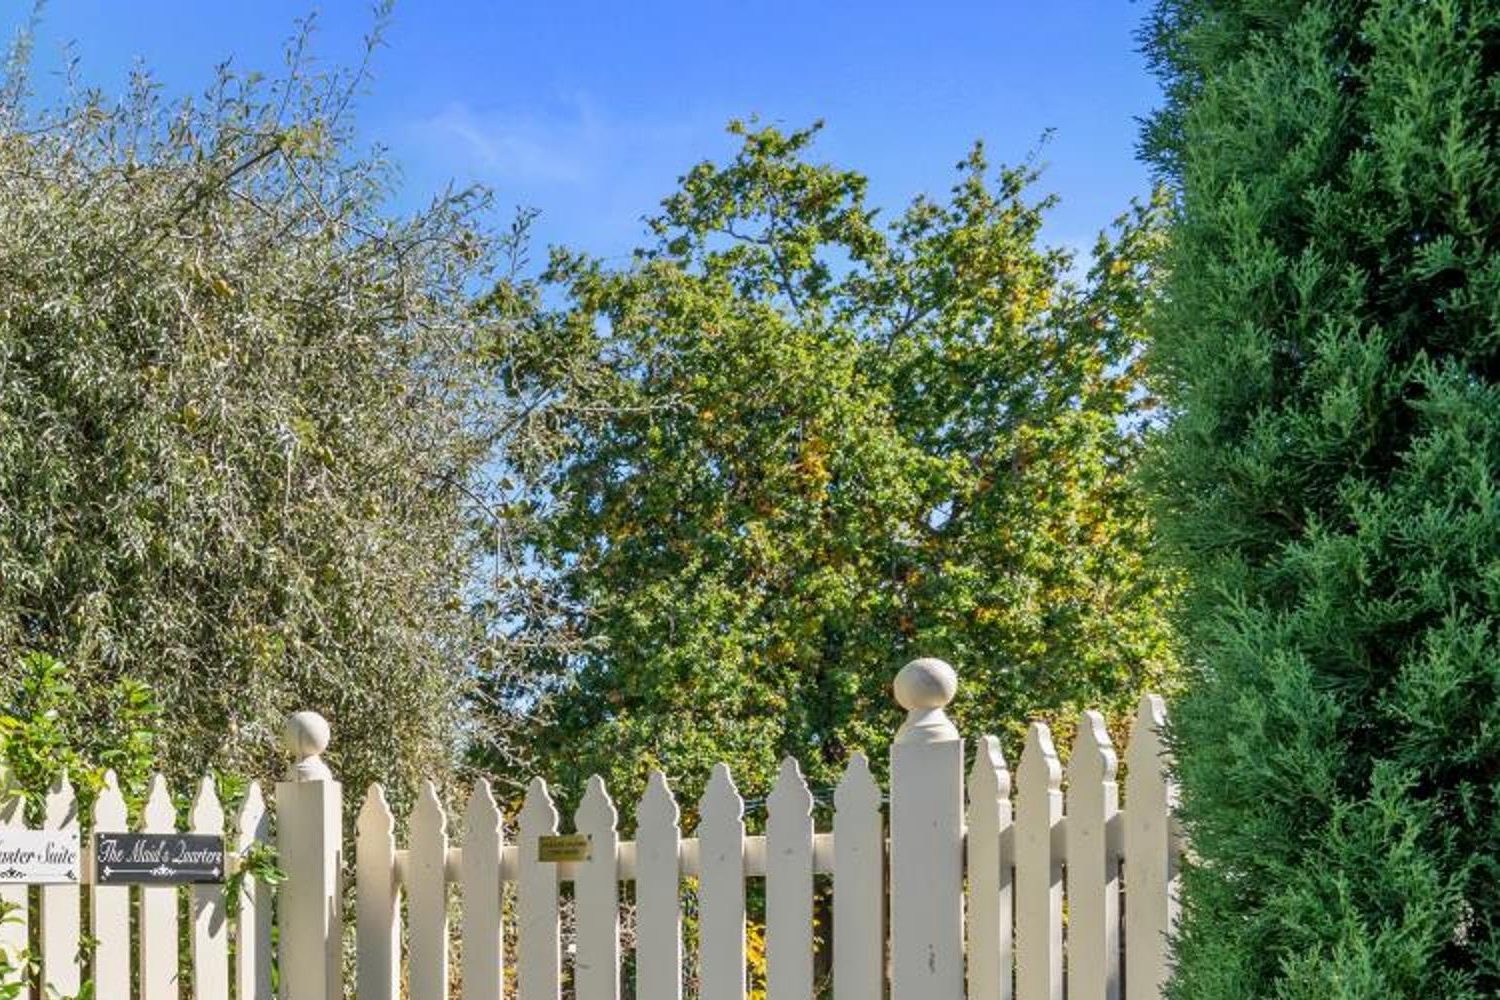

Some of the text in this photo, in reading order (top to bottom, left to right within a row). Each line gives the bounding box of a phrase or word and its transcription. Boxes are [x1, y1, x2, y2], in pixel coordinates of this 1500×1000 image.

[37, 841, 76, 863] Suite
[98, 839, 222, 863] The Maid's Quarters
